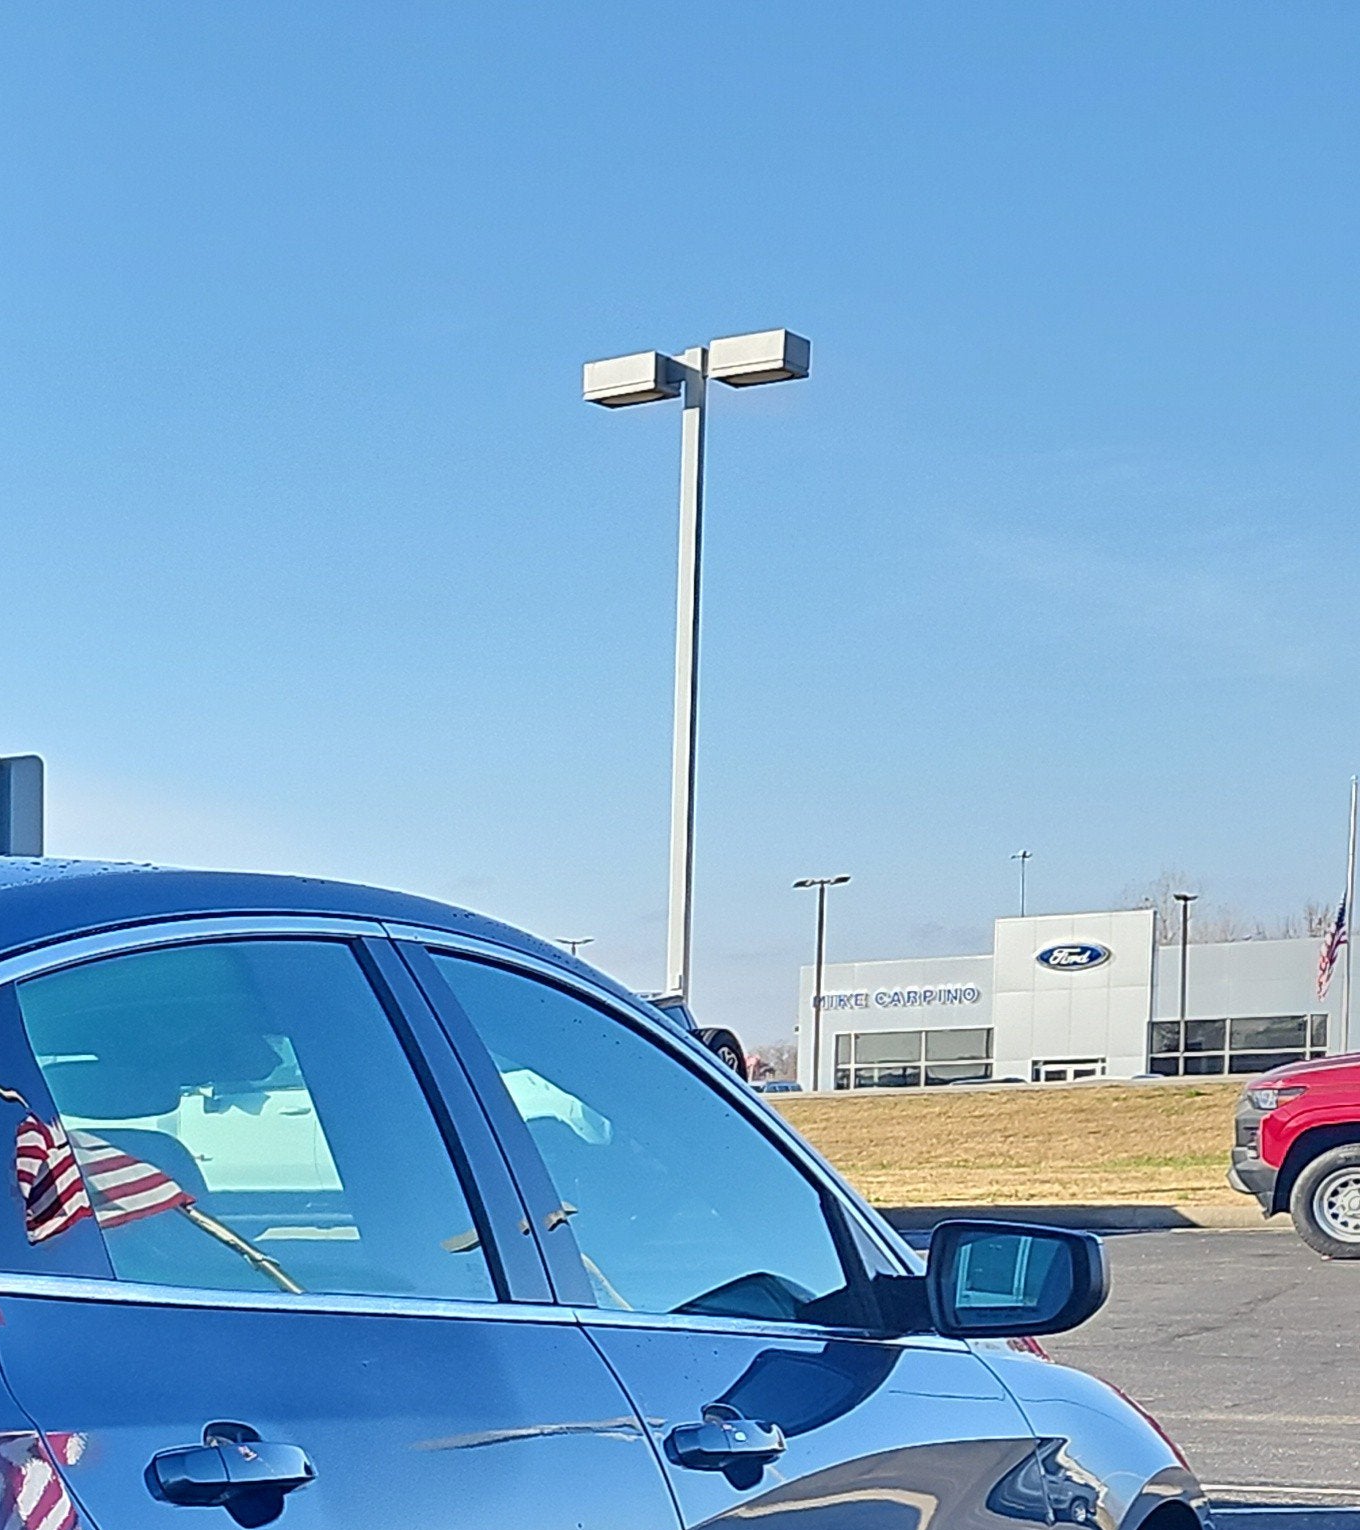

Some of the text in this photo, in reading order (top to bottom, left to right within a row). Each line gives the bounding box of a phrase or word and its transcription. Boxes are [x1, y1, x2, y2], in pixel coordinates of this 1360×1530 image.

[1048, 947, 1092, 965] Ford
[812, 985, 980, 1009] MIKE CARPINO
